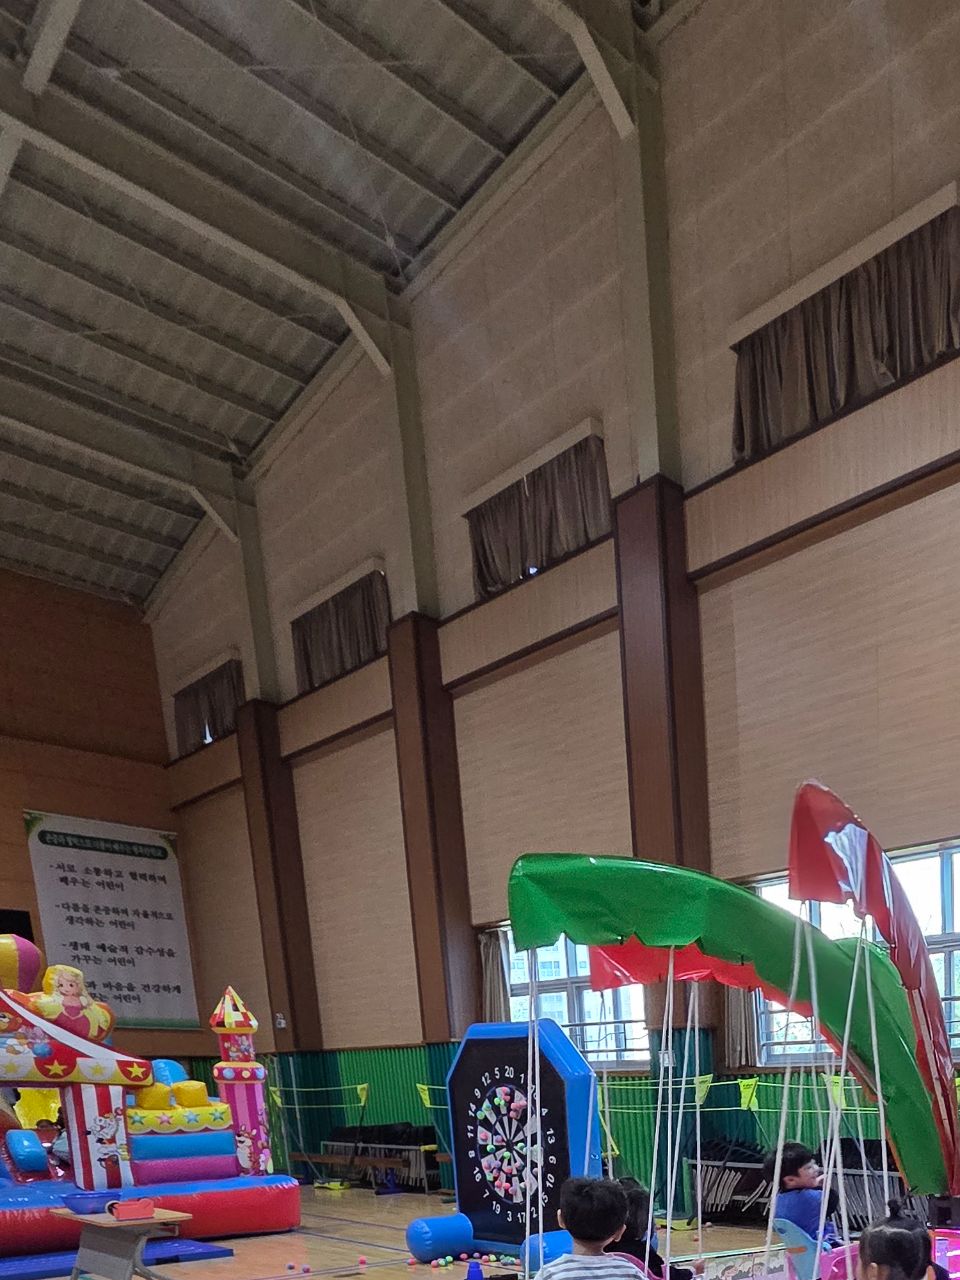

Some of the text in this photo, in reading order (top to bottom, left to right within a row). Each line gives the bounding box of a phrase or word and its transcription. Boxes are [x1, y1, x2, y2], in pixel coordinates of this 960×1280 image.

[96, 881, 125, 892] 어린이
[109, 920, 136, 931] 어린이
[107, 957, 136, 968] 어린이
[102, 982, 137, 992] 마음을
[142, 984, 181, 994] 건강하게
[113, 994, 142, 1003] 어린이
[494, 1067, 500, 1079] 5
[505, 1065, 514, 1078] 20
[481, 1072, 491, 1086] 12
[519, 1073, 525, 1084] 1
[474, 1088, 481, 1098] 9
[468, 1102, 477, 1117] 14
[467, 1125, 474, 1138] 11
[546, 1128, 555, 1144] 13
[468, 1150, 476, 1158] 8
[473, 1166, 482, 1182] 16
[546, 1173, 555, 1188] 10
[482, 1189, 490, 1198] 7
[492, 1201, 501, 1214] 19
[530, 1207, 537, 1218] 2
[507, 1211, 512, 1222] 3
[517, 1212, 526, 1223] 17
